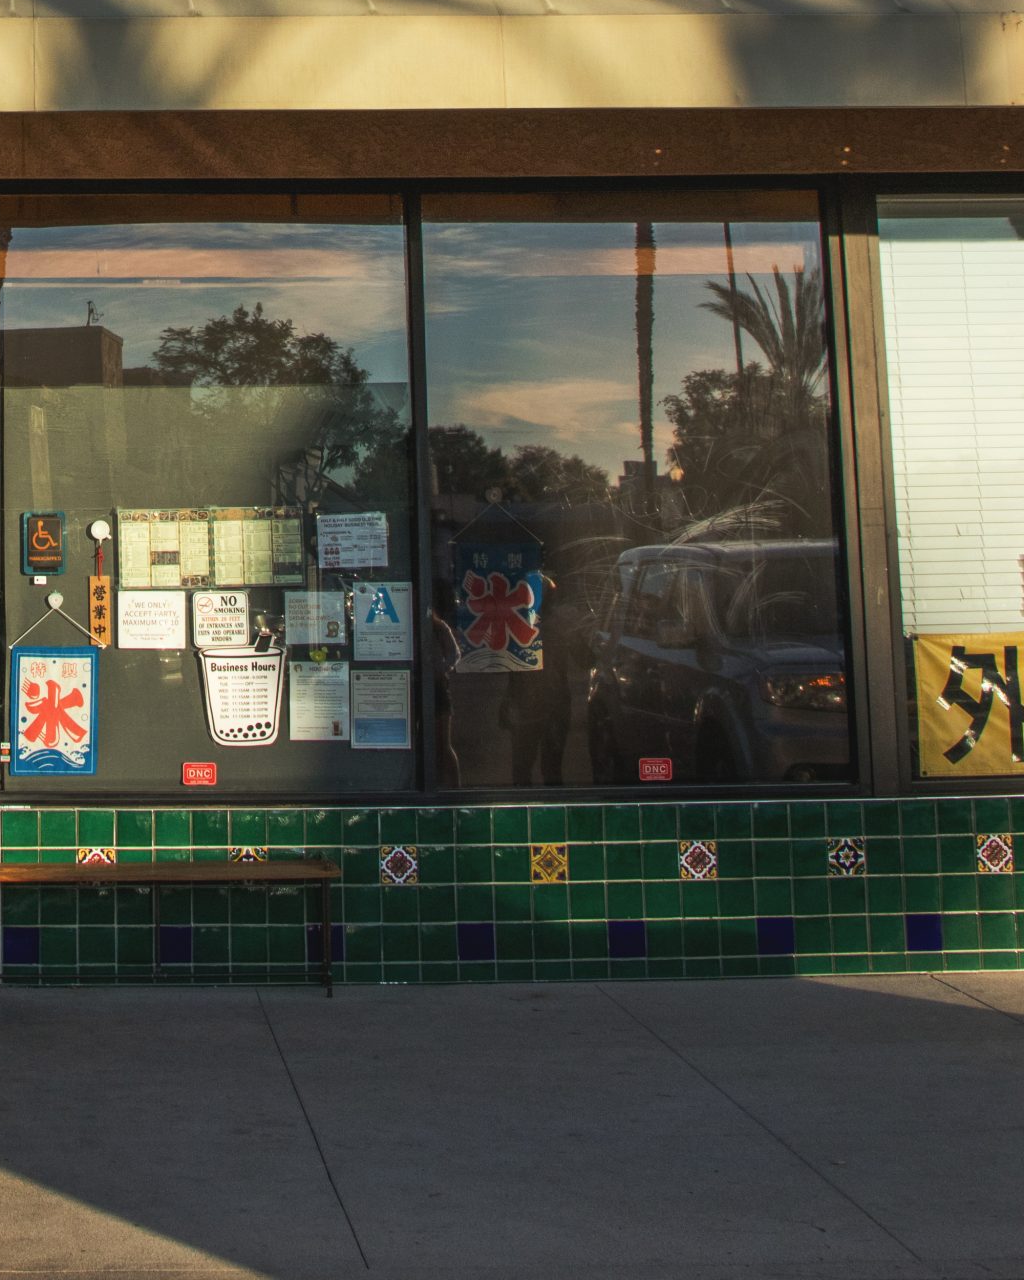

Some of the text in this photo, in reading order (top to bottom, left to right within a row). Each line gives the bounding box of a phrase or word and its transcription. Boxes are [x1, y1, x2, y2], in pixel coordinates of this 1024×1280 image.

[134, 601, 167, 609] WE ONLY
[220, 595, 237, 607] NO
[365, 587, 401, 624] A
[210, 661, 276, 672] Business Hours
[189, 769, 210, 778] DNC
[644, 765, 666, 773] DNC
